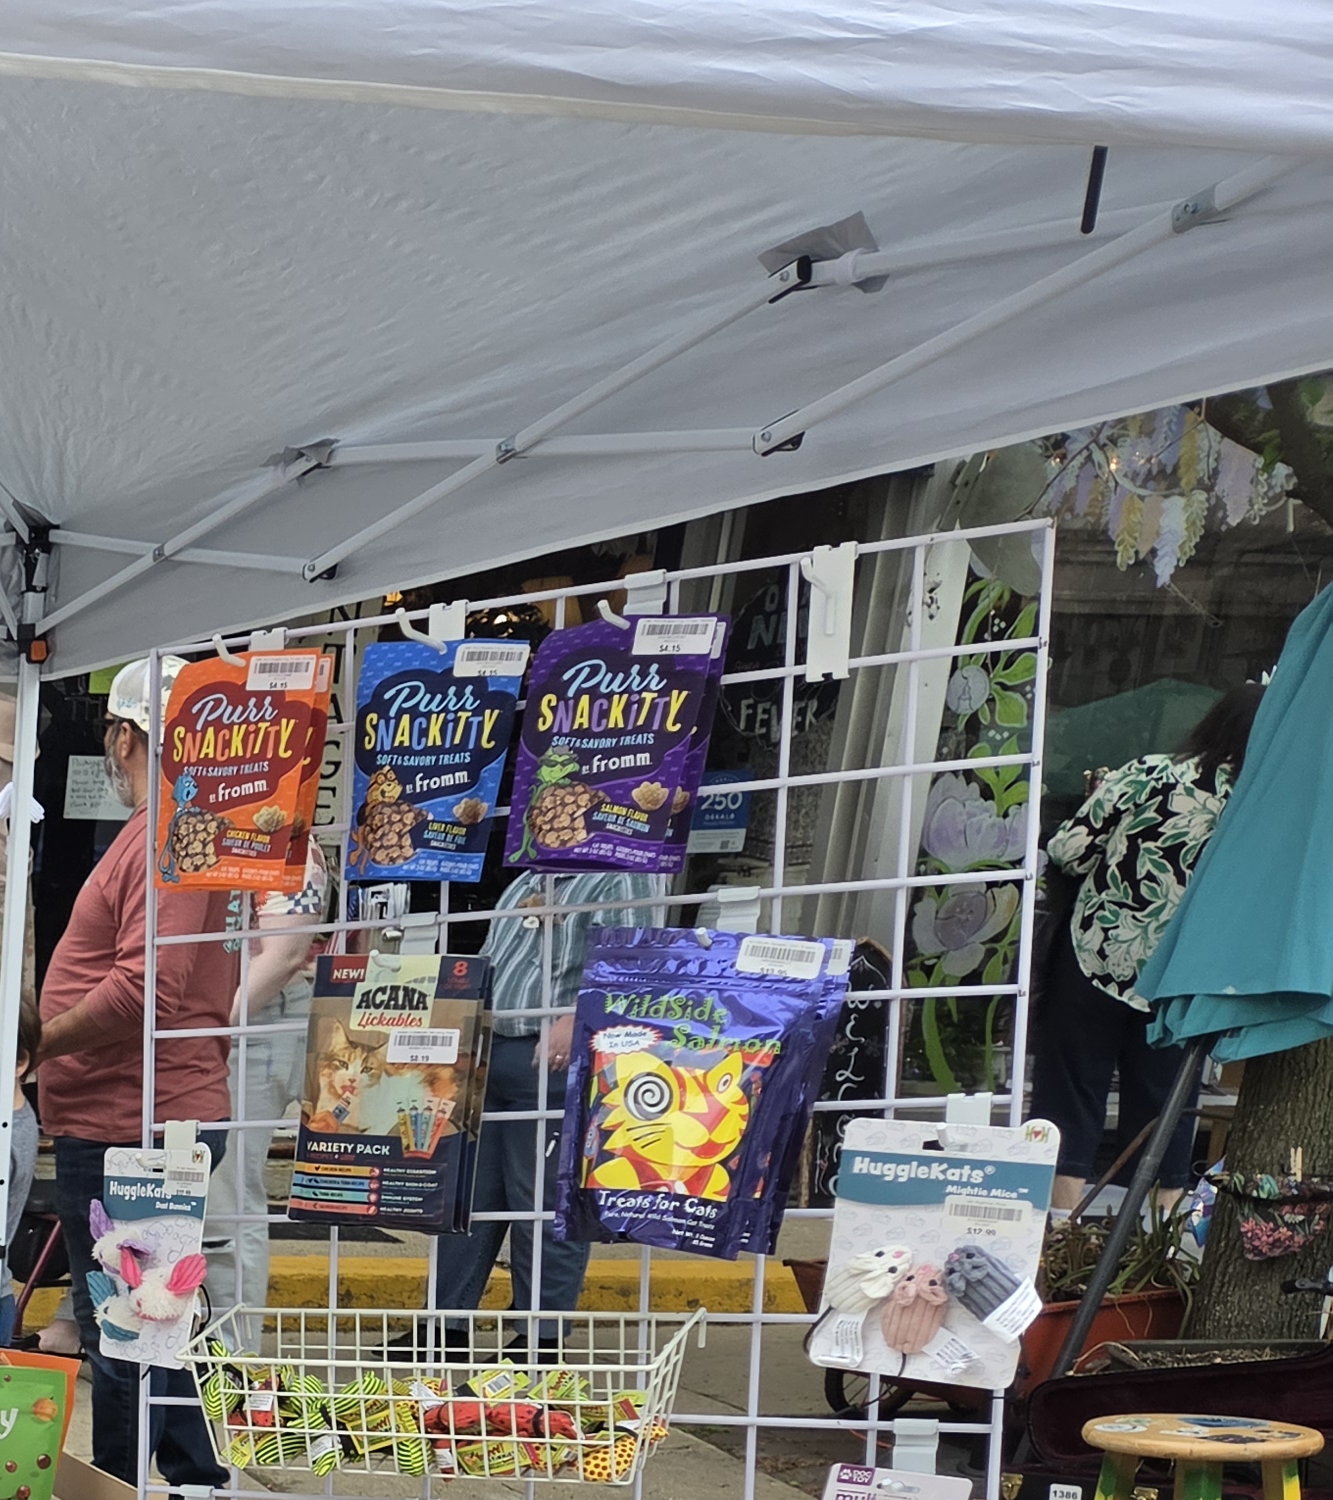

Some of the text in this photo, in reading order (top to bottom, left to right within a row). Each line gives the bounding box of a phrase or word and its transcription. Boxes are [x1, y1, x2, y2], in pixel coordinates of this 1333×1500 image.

[563, 659, 667, 697] Purr
[384, 681, 480, 716] Purr
[193, 693, 278, 730] Purr
[620, 734, 654, 746] TREATS
[438, 752, 470, 765] TREATS
[593, 752, 650, 773] fromm
[239, 761, 269, 775] TREATS
[416, 770, 469, 792] fromm
[218, 779, 267, 802] fromm
[701, 792, 743, 810] 250
[333, 967, 365, 980] NEW!
[453, 960, 468, 977] 8
[355, 985, 429, 1011] ACANA
[604, 993, 728, 1024] WildSide
[357, 1011, 423, 1028] Lickables
[603, 1030, 647, 1041] Now Made
[609, 1040, 640, 1049] In USA
[667, 1025, 782, 1054] Salmon
[306, 1140, 390, 1156] VARIETY PACK
[852, 1156, 984, 1185] HuggleKats
[946, 1184, 1018, 1199] Mightie Mice
[598, 1190, 718, 1218] Treats for Cats
[1053, 1490, 1078, 1500] 1386
